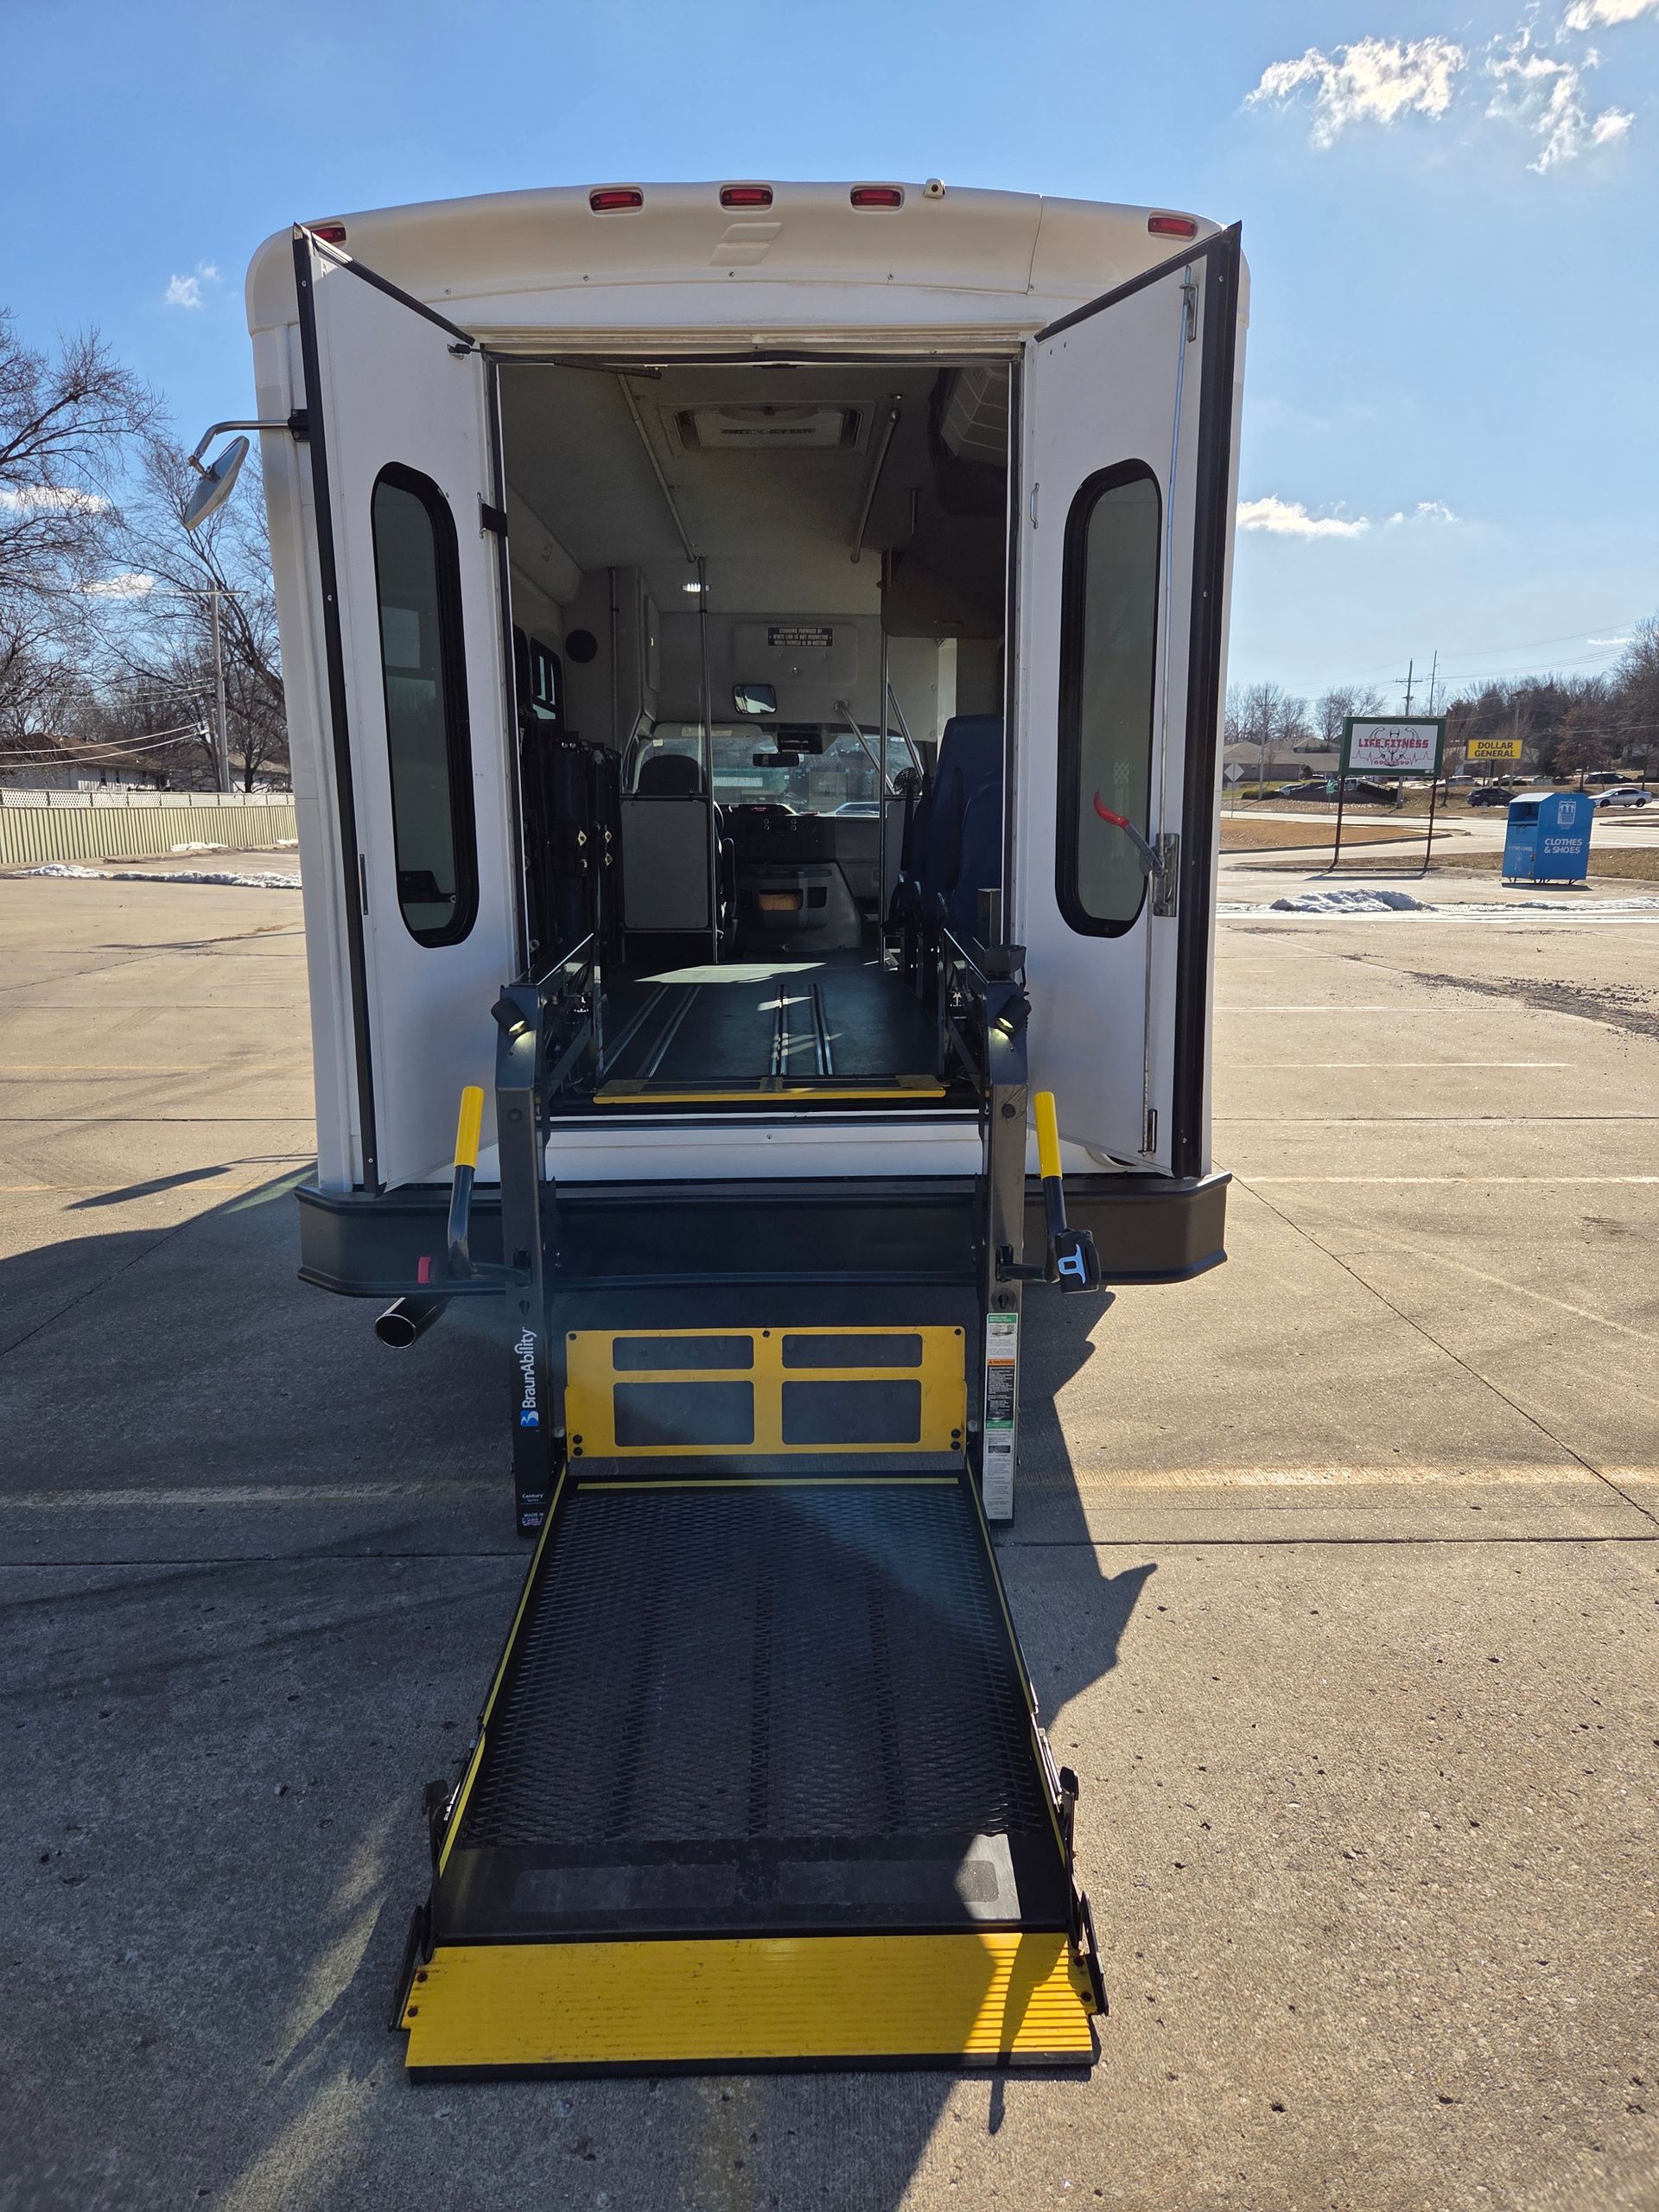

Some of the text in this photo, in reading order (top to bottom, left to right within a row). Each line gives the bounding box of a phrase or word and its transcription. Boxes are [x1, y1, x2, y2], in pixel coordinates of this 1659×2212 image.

[1358, 738, 1429, 748] LIFE FITNESS
[515, 1329, 537, 1408] BraunAbility
